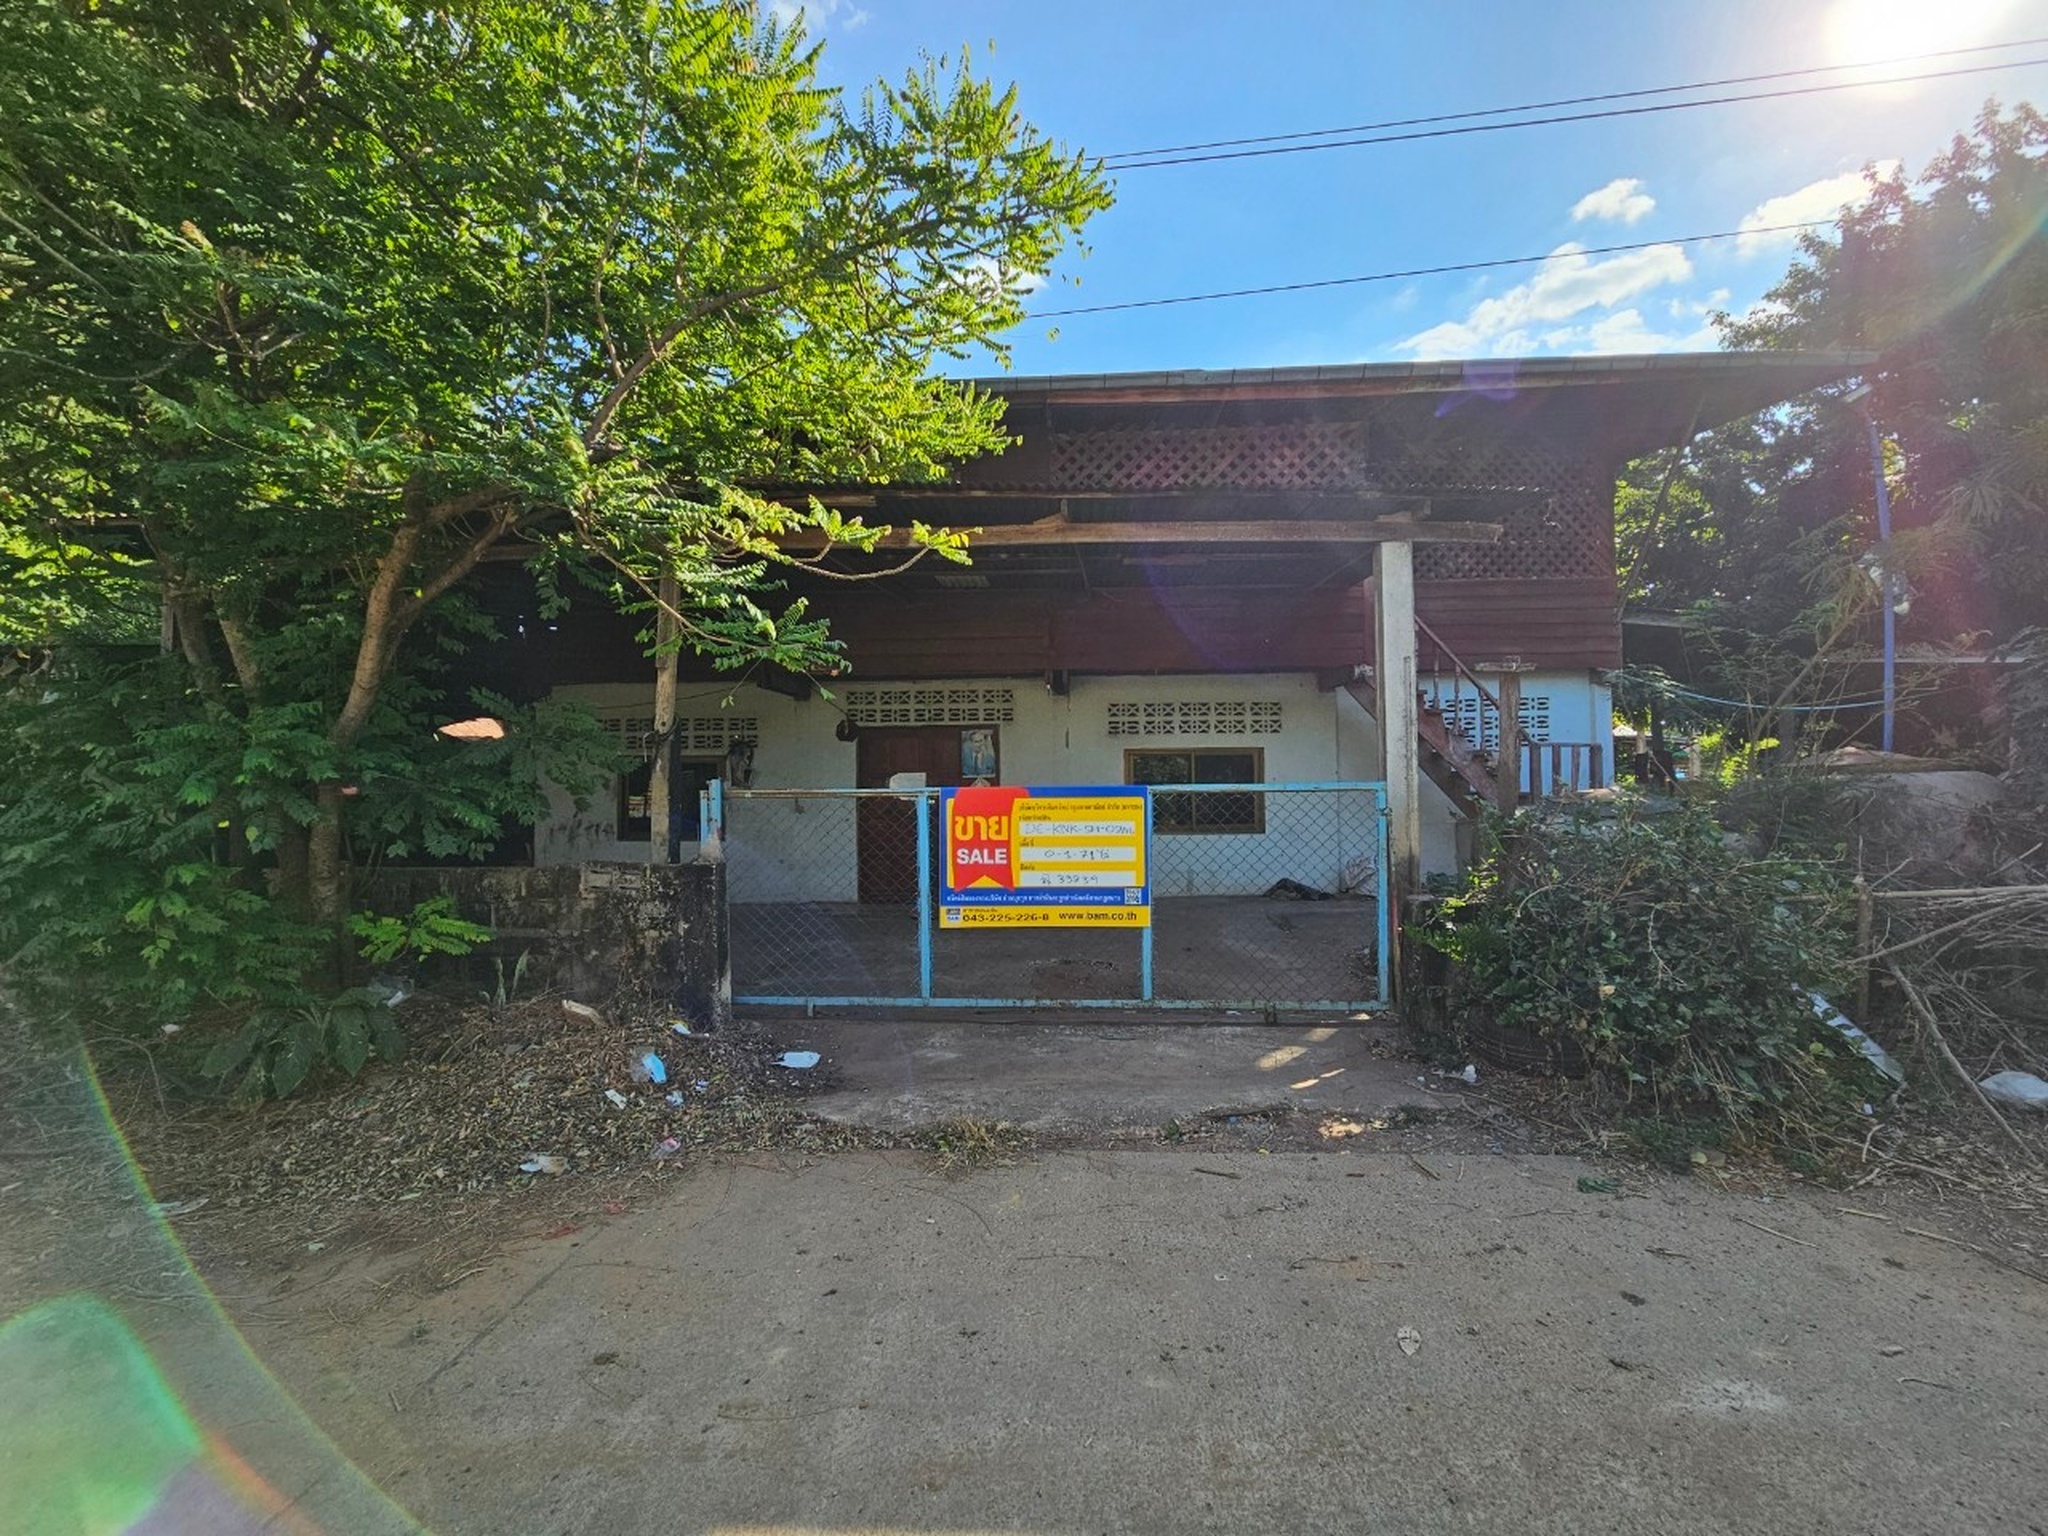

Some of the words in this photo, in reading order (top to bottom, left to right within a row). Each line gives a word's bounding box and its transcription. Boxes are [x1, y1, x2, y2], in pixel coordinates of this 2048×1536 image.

[955, 815, 1009, 841] ขาย
[957, 848, 1007, 864] SALE
[1059, 911, 1137, 921] www.bam.co.th
